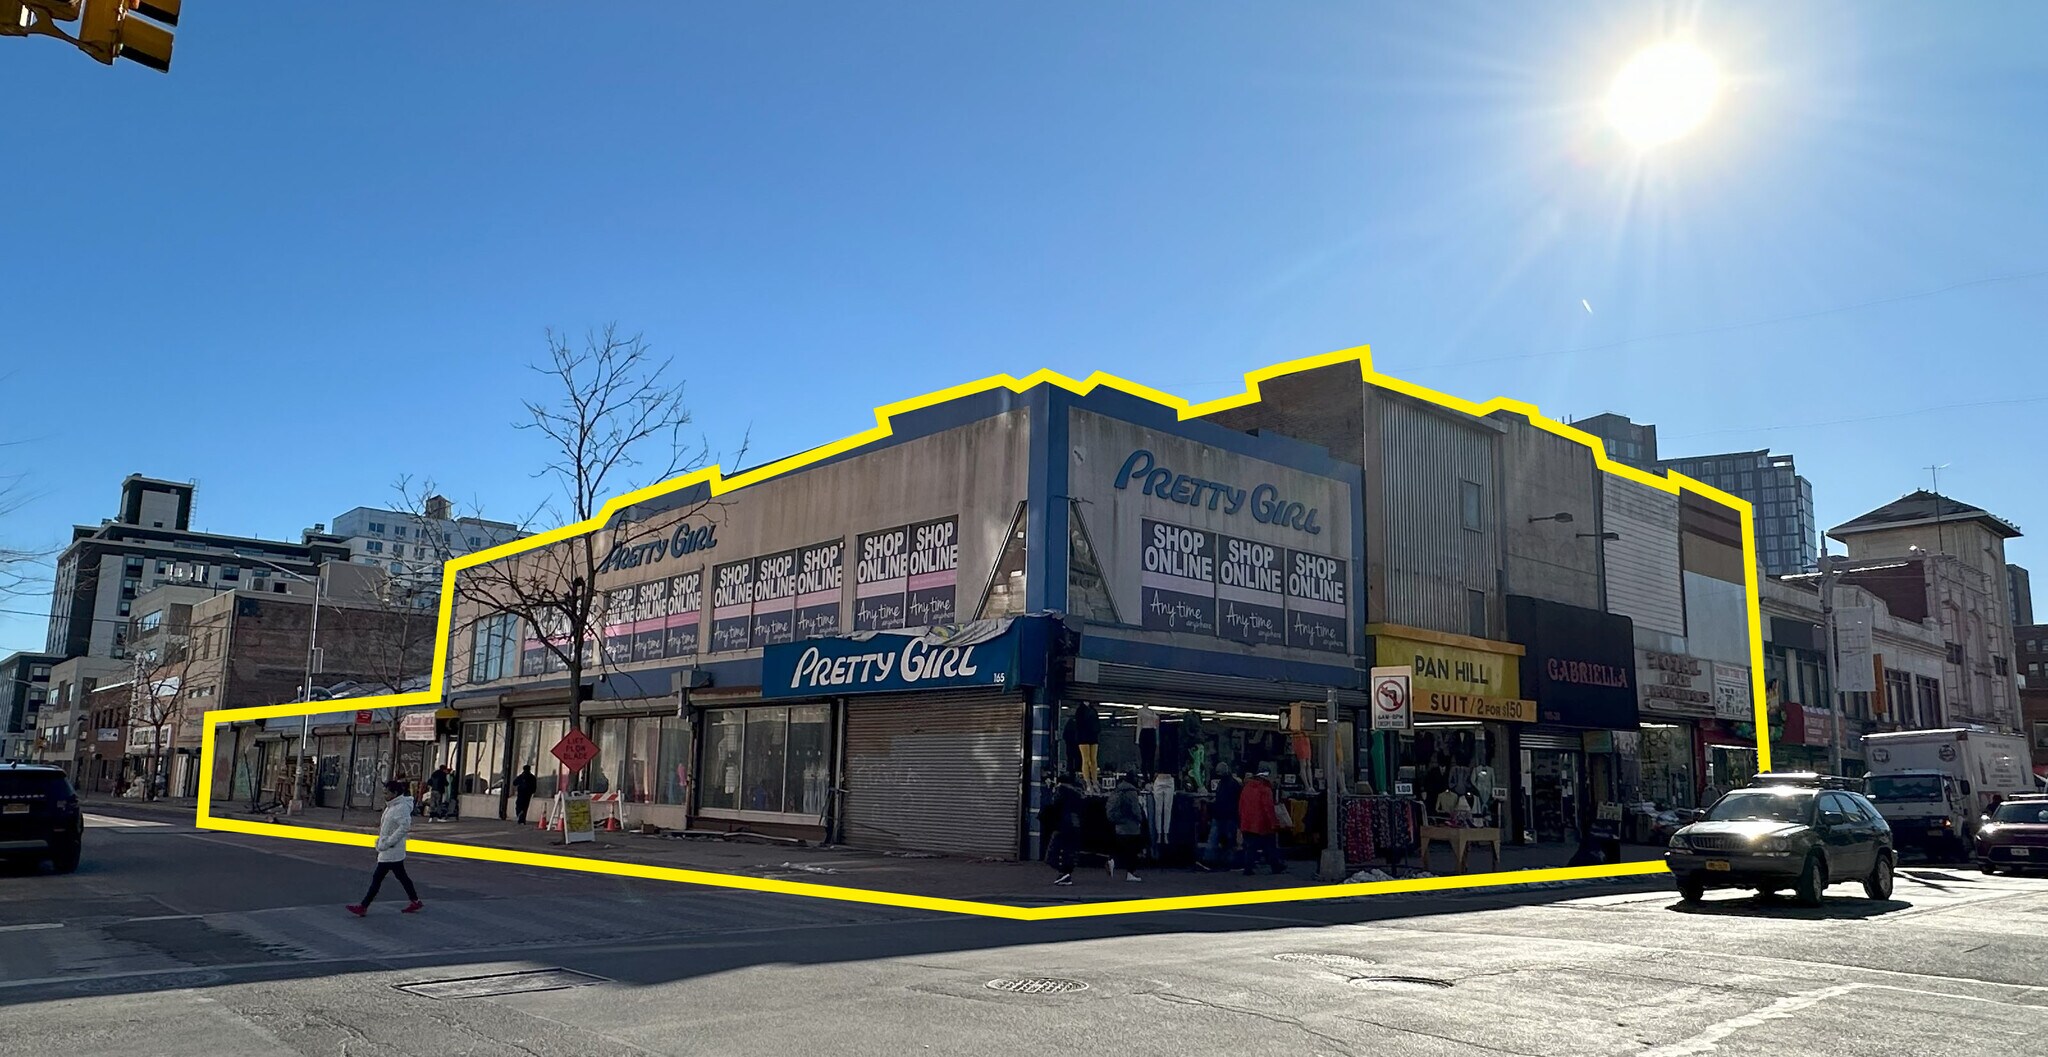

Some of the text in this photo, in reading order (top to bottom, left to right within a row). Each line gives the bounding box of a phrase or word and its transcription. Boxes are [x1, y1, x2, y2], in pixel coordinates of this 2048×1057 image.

[1114, 449, 1321, 535] PRETTY GIRL
[671, 523, 718, 558] GIRL
[864, 532, 904, 560] SHOP
[916, 522, 954, 550] SHOP
[1154, 524, 1205, 555] SHOP
[803, 545, 837, 570] SHOP
[910, 544, 958, 575] ONLINE
[1145, 546, 1213, 581] ONLINE
[1228, 539, 1274, 569] SHOP
[1296, 553, 1336, 580] SHOP
[720, 564, 749, 587] SHOP
[760, 556, 792, 581] SHOP
[798, 566, 842, 594] ONLINE
[858, 553, 907, 584] ONLINE
[1221, 560, 1281, 593] ONLINE
[640, 582, 665, 602] SHOP
[673, 574, 699, 596] SHOP
[715, 582, 752, 608] ONLINE
[755, 575, 795, 601] ONLINE
[1289, 574, 1344, 604] ONLINE
[636, 599, 667, 621] ONLINE
[668, 591, 702, 615] ONLINE
[790, 636, 978, 688] PRETTY GIRL
[1415, 655, 1488, 685] PAN HILL
[1548, 658, 1628, 688] GABRIELLA
[993, 673, 1005, 683] 165
[1485, 705, 1500, 716] FOR
[1503, 701, 1522, 718] $150
